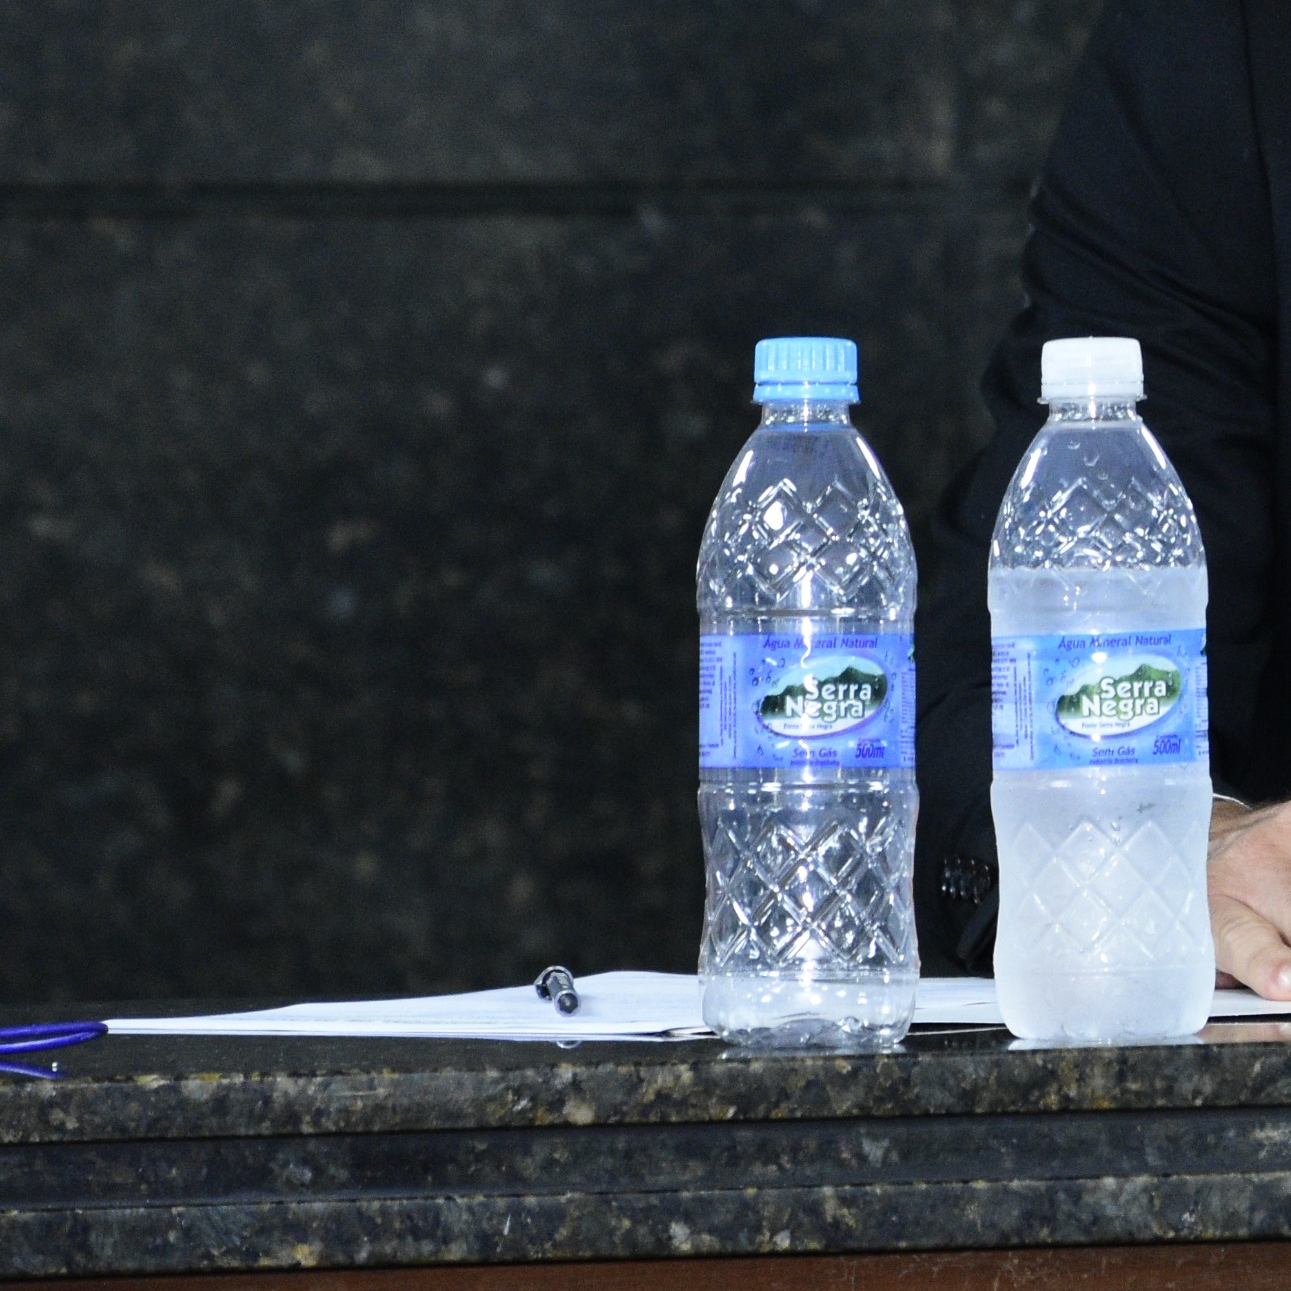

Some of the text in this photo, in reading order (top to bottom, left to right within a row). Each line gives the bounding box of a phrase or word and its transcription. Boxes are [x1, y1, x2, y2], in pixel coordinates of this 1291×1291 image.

[794, 634, 837, 649] Meral
[841, 636, 878, 649] Natural
[1136, 634, 1172, 647] Natural
[805, 678, 873, 701] Serra
[1099, 677, 1167, 700] Serra
[784, 695, 866, 722] Negra
[1081, 695, 1161, 721] Negra
[1092, 747, 1114, 758] Sem
